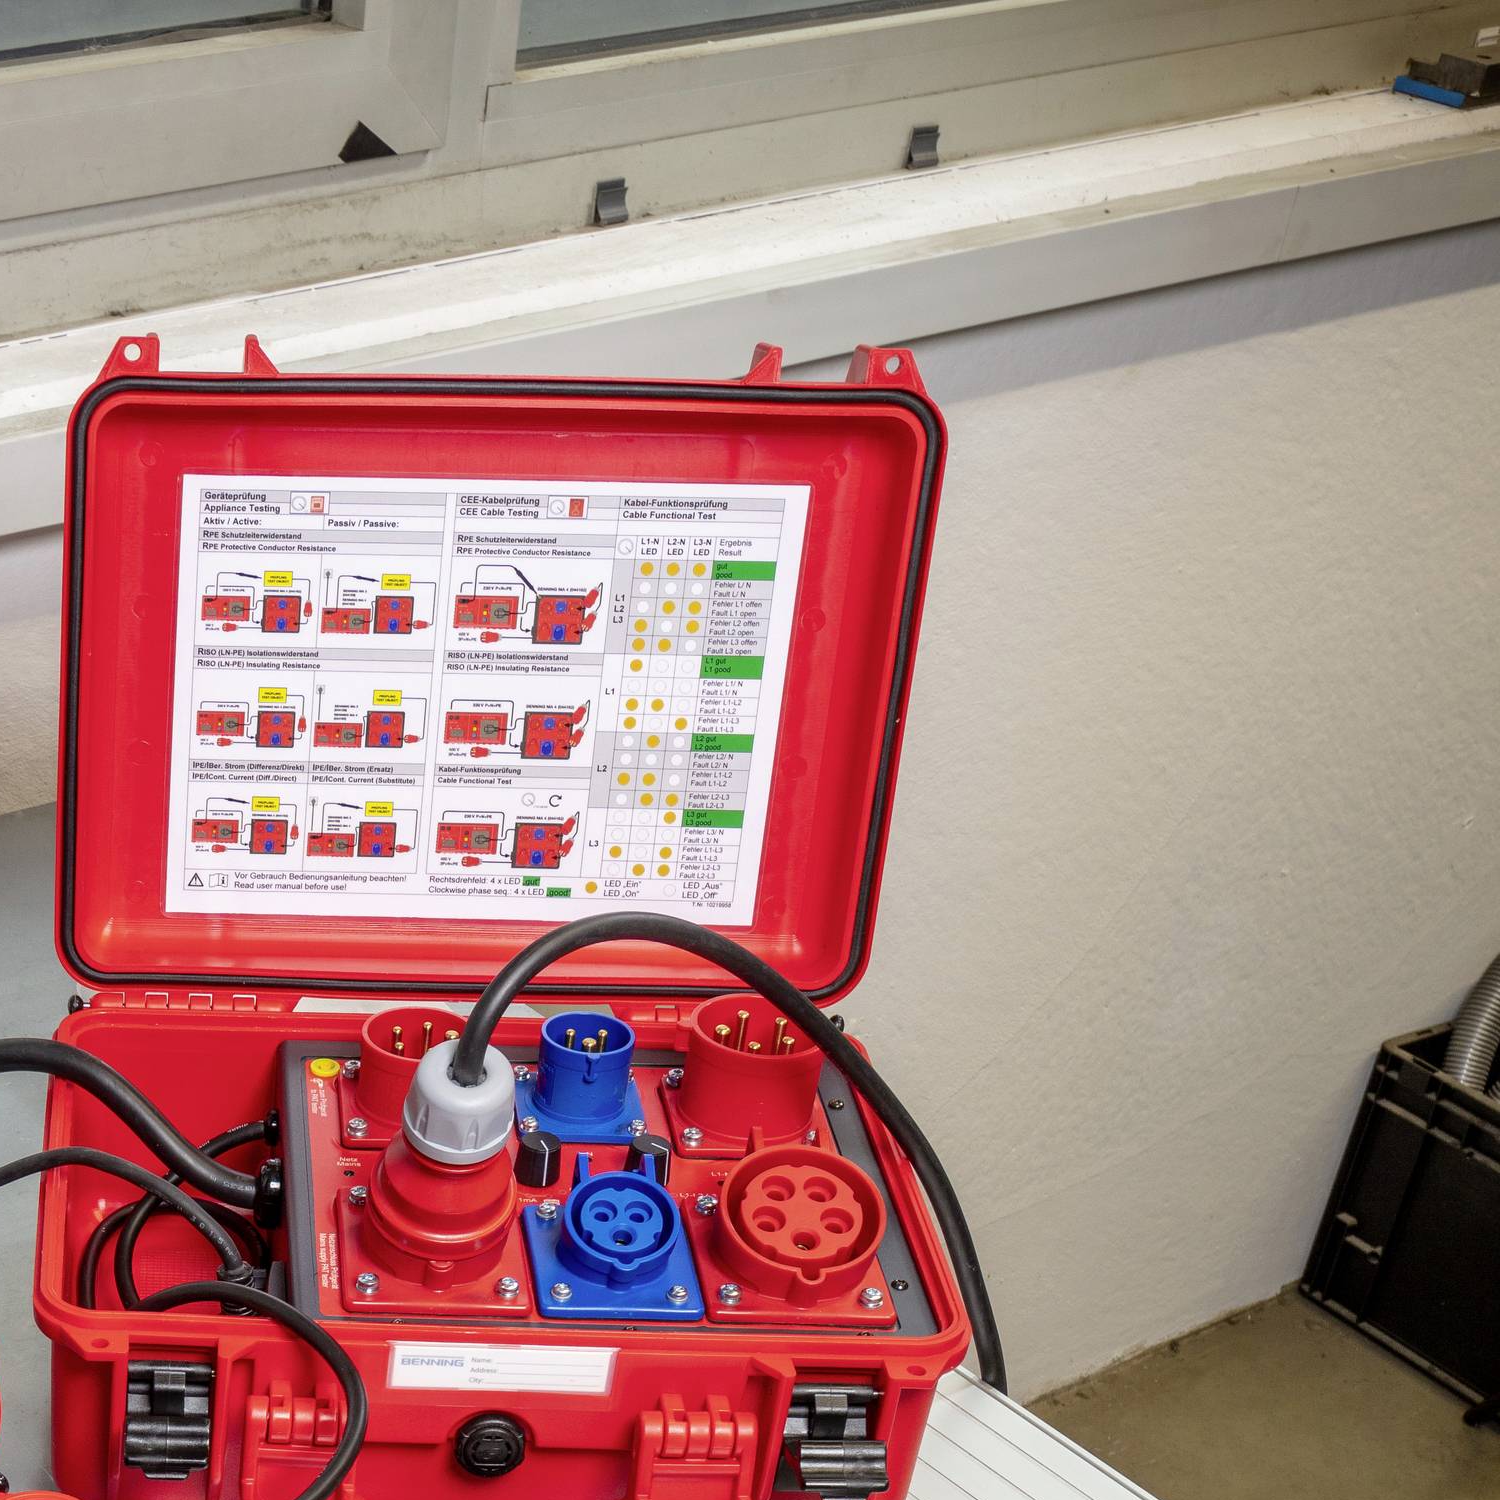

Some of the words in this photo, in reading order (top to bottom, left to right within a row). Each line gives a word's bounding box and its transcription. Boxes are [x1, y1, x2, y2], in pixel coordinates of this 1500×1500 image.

[205, 492, 266, 501] Geräteprüfung
[461, 496, 540, 506] CEE-Kabelprüfung
[624, 499, 728, 510] Kabel-Funktionsprüfung
[204, 504, 246, 513] Appliance
[249, 505, 280, 514] Testing
[481, 508, 504, 516] Cable
[508, 509, 539, 518] Testing
[623, 511, 647, 519] Cable
[650, 512, 696, 520] Functional
[698, 512, 716, 520] Test
[203, 517, 225, 525] Aktiv
[221, 532, 301, 540] Schutzleiterwiderstand
[476, 536, 557, 544] Schutzleiterwiderstand
[720, 539, 752, 547] Ergebnis
[496, 653, 568, 661] Isolationswiderstand
[495, 665, 529, 673] Insulating
[438, 767, 521, 775] Kabel-Funktionsprüfung
[289, 874, 367, 882] Bedienungsanleitung
[430, 876, 488, 884] Rechtsdrehfeld:
[428, 886, 466, 894] Clockwise
[469, 887, 492, 895] phase
[528, 888, 544, 896] LED
[401, 1357, 464, 1367] BENNING
